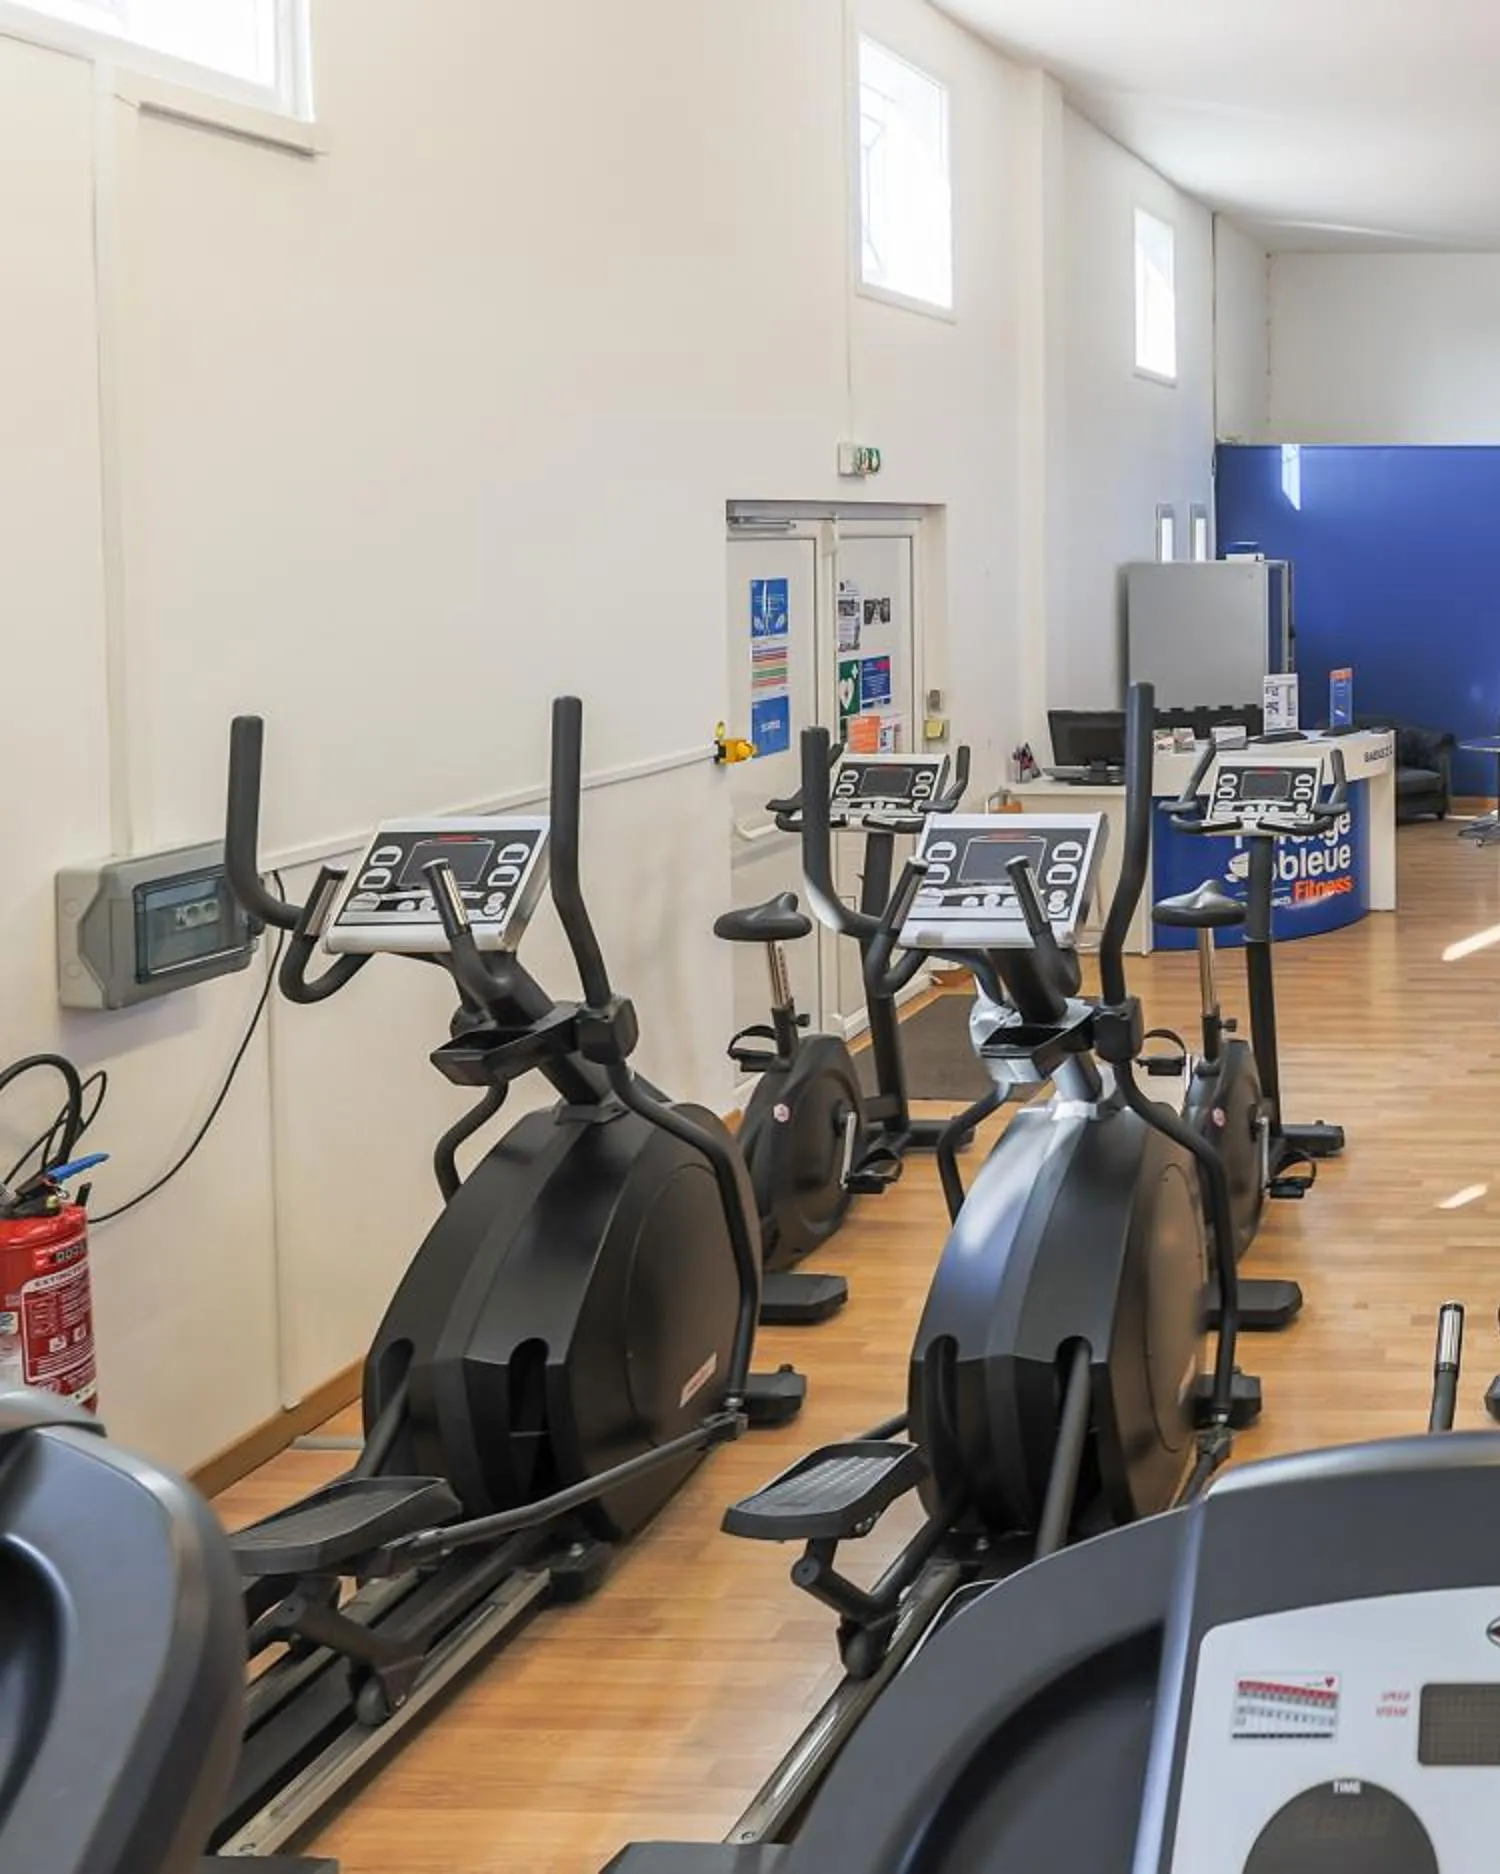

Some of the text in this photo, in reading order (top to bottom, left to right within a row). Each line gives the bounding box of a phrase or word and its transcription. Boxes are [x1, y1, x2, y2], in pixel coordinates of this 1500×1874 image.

[1279, 843, 1351, 881] bleue
[1294, 875, 1353, 902] Fitness
[1333, 1780, 1361, 1795] TIME
